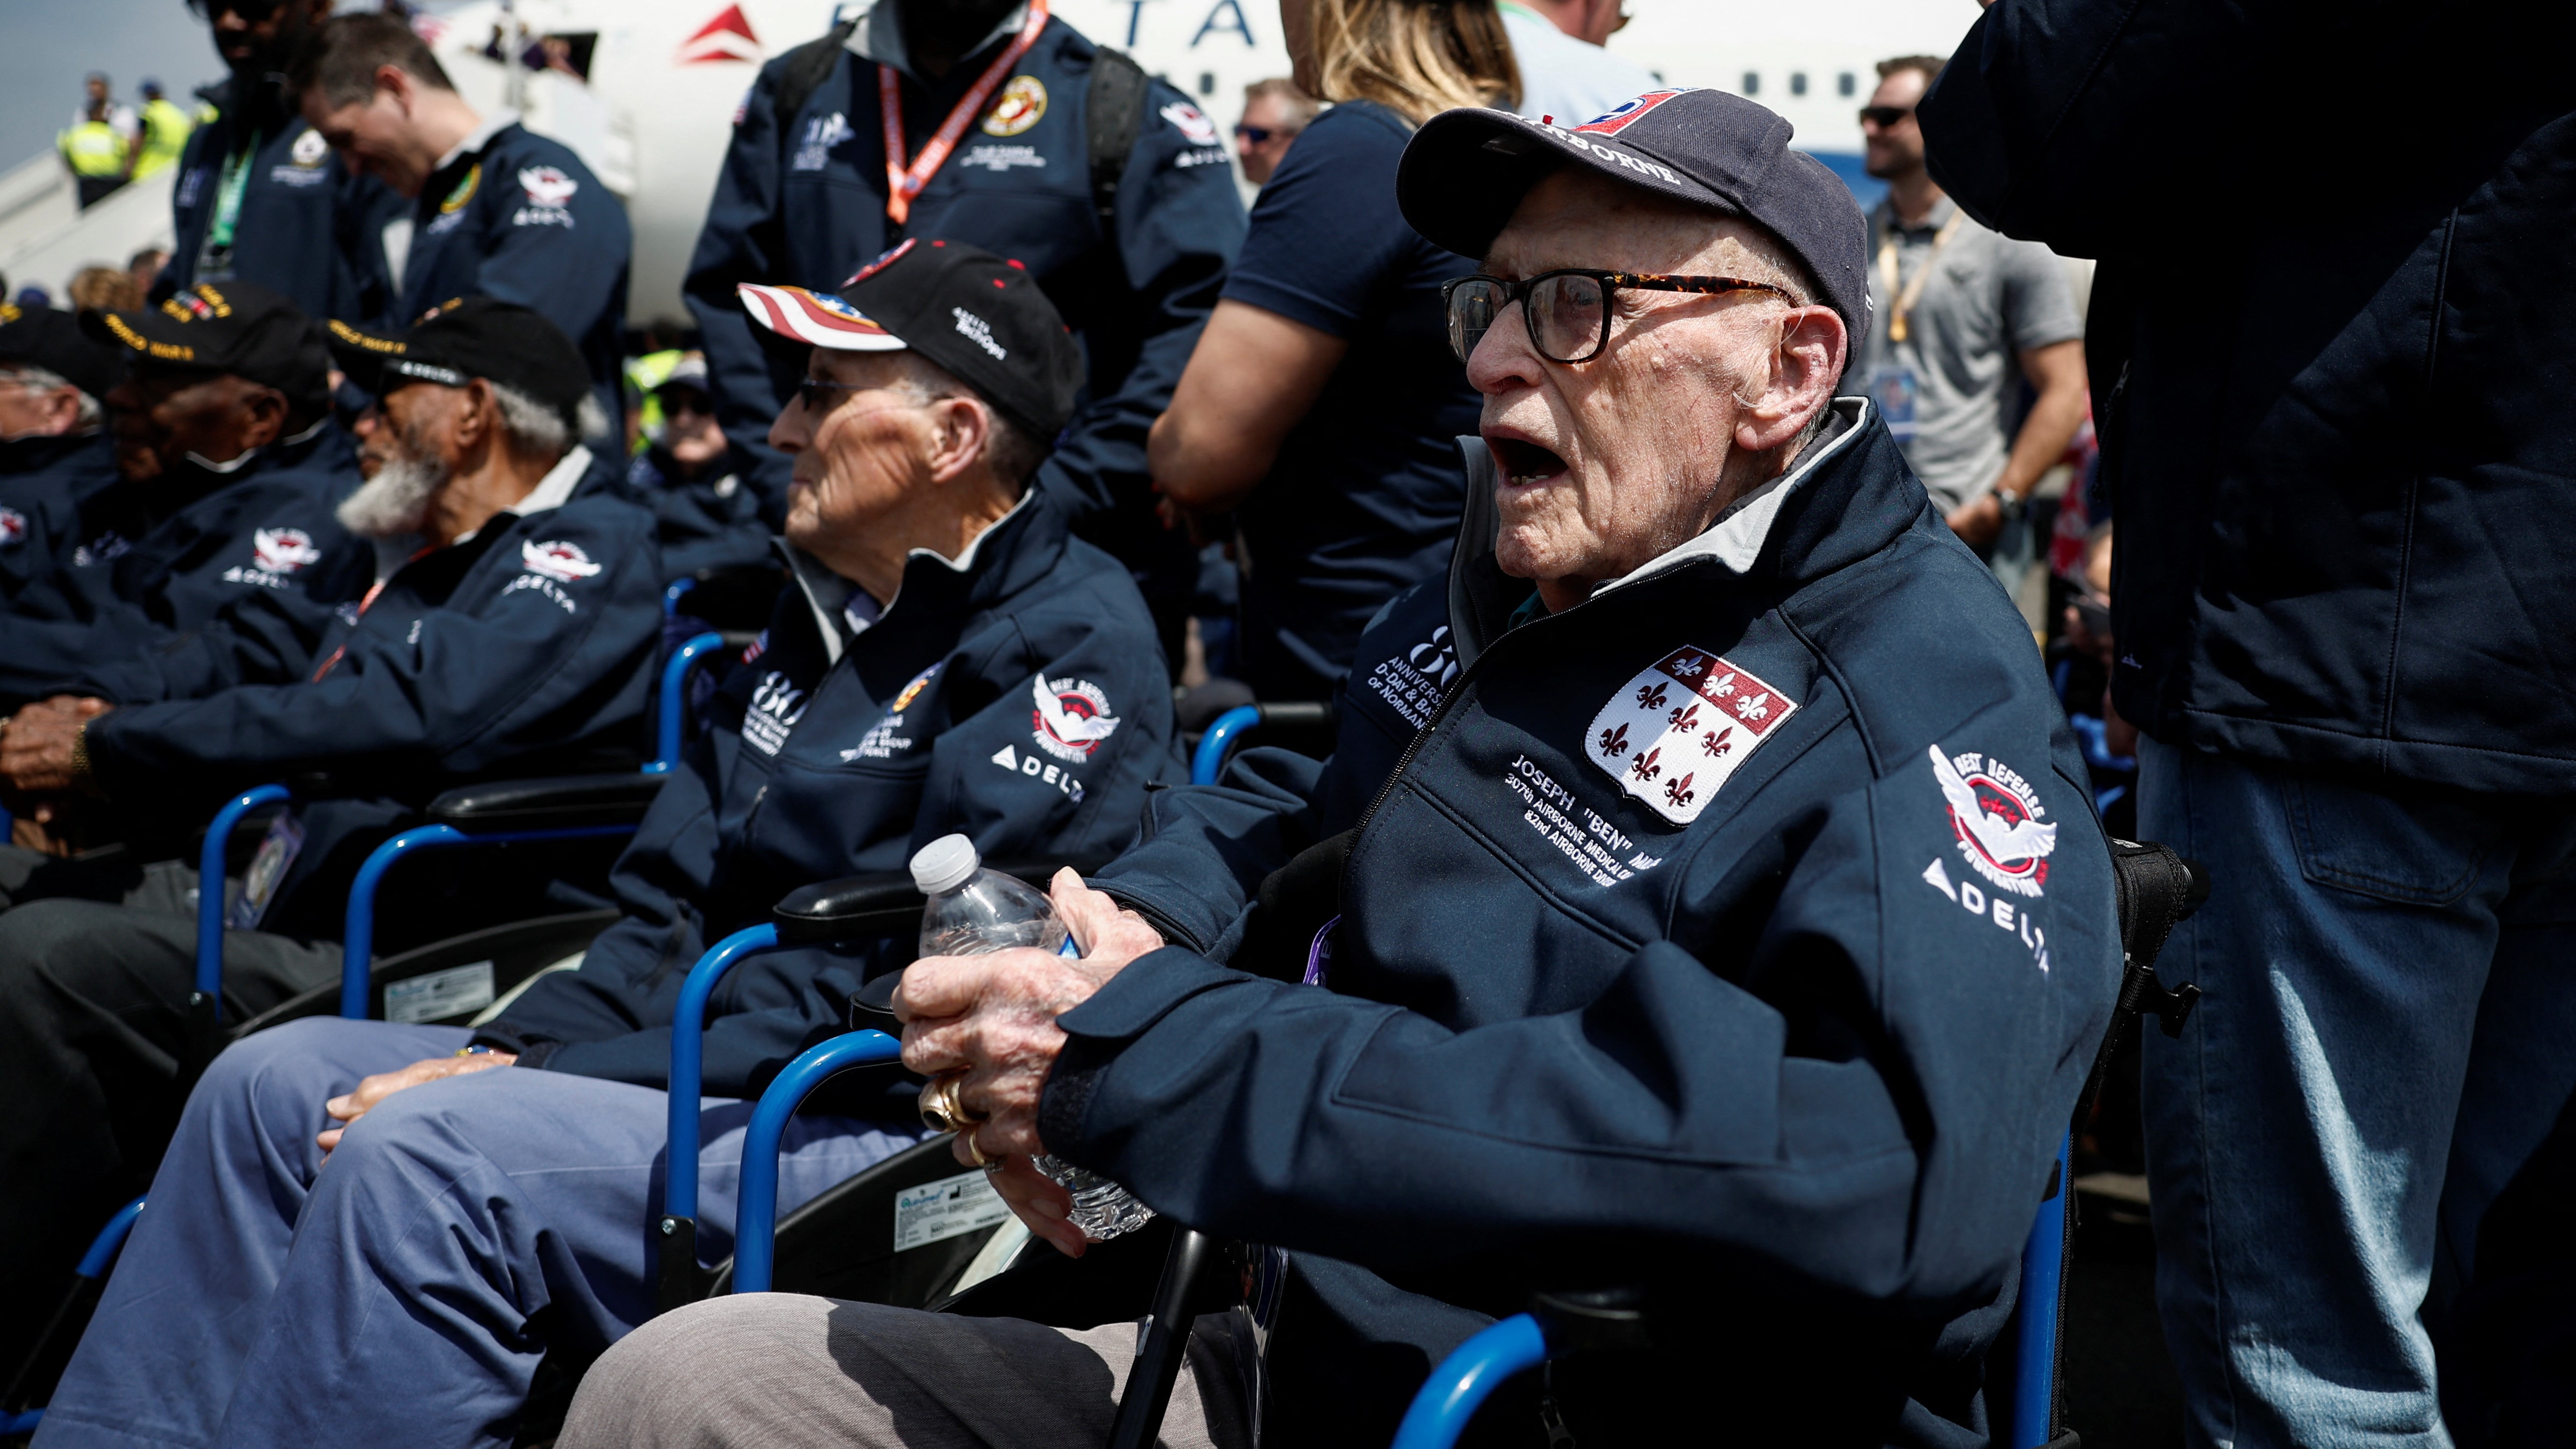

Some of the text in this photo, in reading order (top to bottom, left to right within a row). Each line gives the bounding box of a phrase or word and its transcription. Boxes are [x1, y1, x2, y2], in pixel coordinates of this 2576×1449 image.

[1367, 677, 1383, 689] OF
[1375, 663, 1435, 717] D-DAY & BA
[1388, 656, 1443, 706] ANNIVERS
[1021, 755, 1086, 803] DELTA
[1511, 754, 1576, 811] JOSEPH
[1583, 808, 1633, 850] "BEN"
[1953, 752, 2045, 818] BEST DEFENSE
[1505, 773, 1534, 803] 307th
[1533, 798, 1587, 845] AIRBORNE
[1583, 839, 1622, 875] MEDICAL
[1524, 810, 1552, 835] 82nd
[1547, 830, 1597, 875] AIRBORNE
[1961, 881, 2050, 977] DELTA
